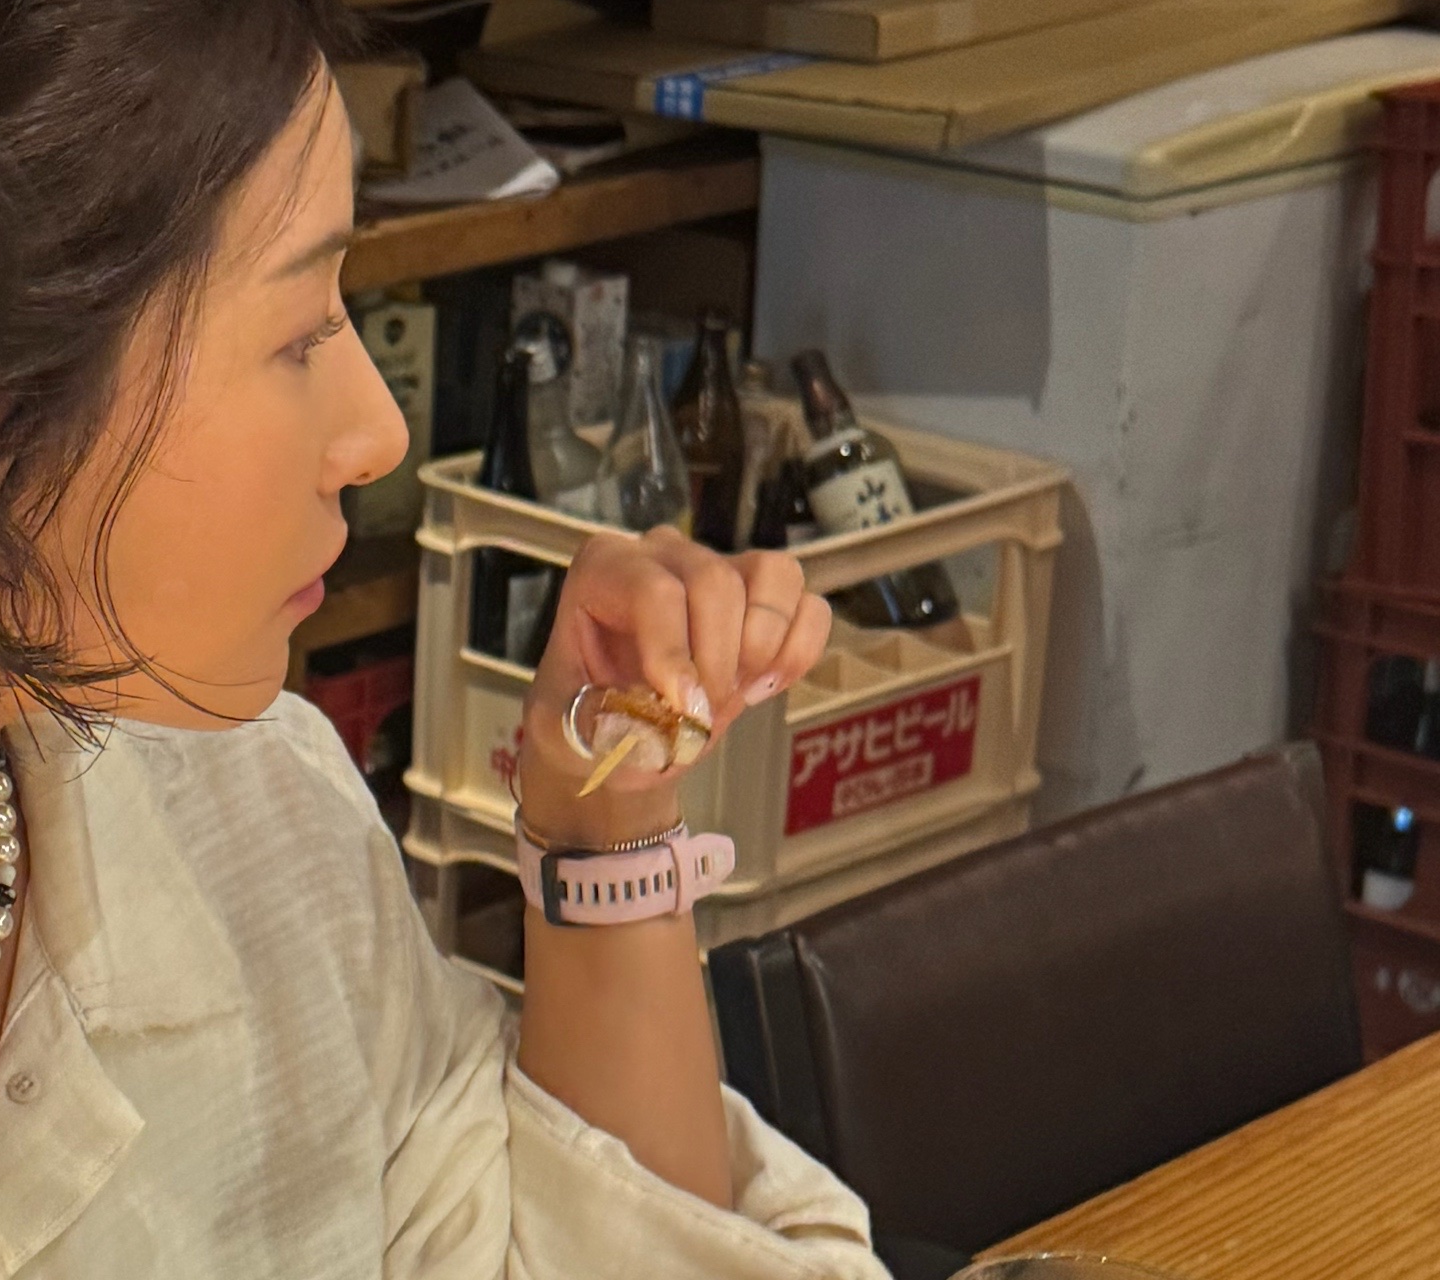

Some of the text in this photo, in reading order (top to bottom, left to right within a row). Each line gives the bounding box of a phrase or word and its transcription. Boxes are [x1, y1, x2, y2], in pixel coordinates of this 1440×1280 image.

[794, 689, 972, 787] アサヒビール
